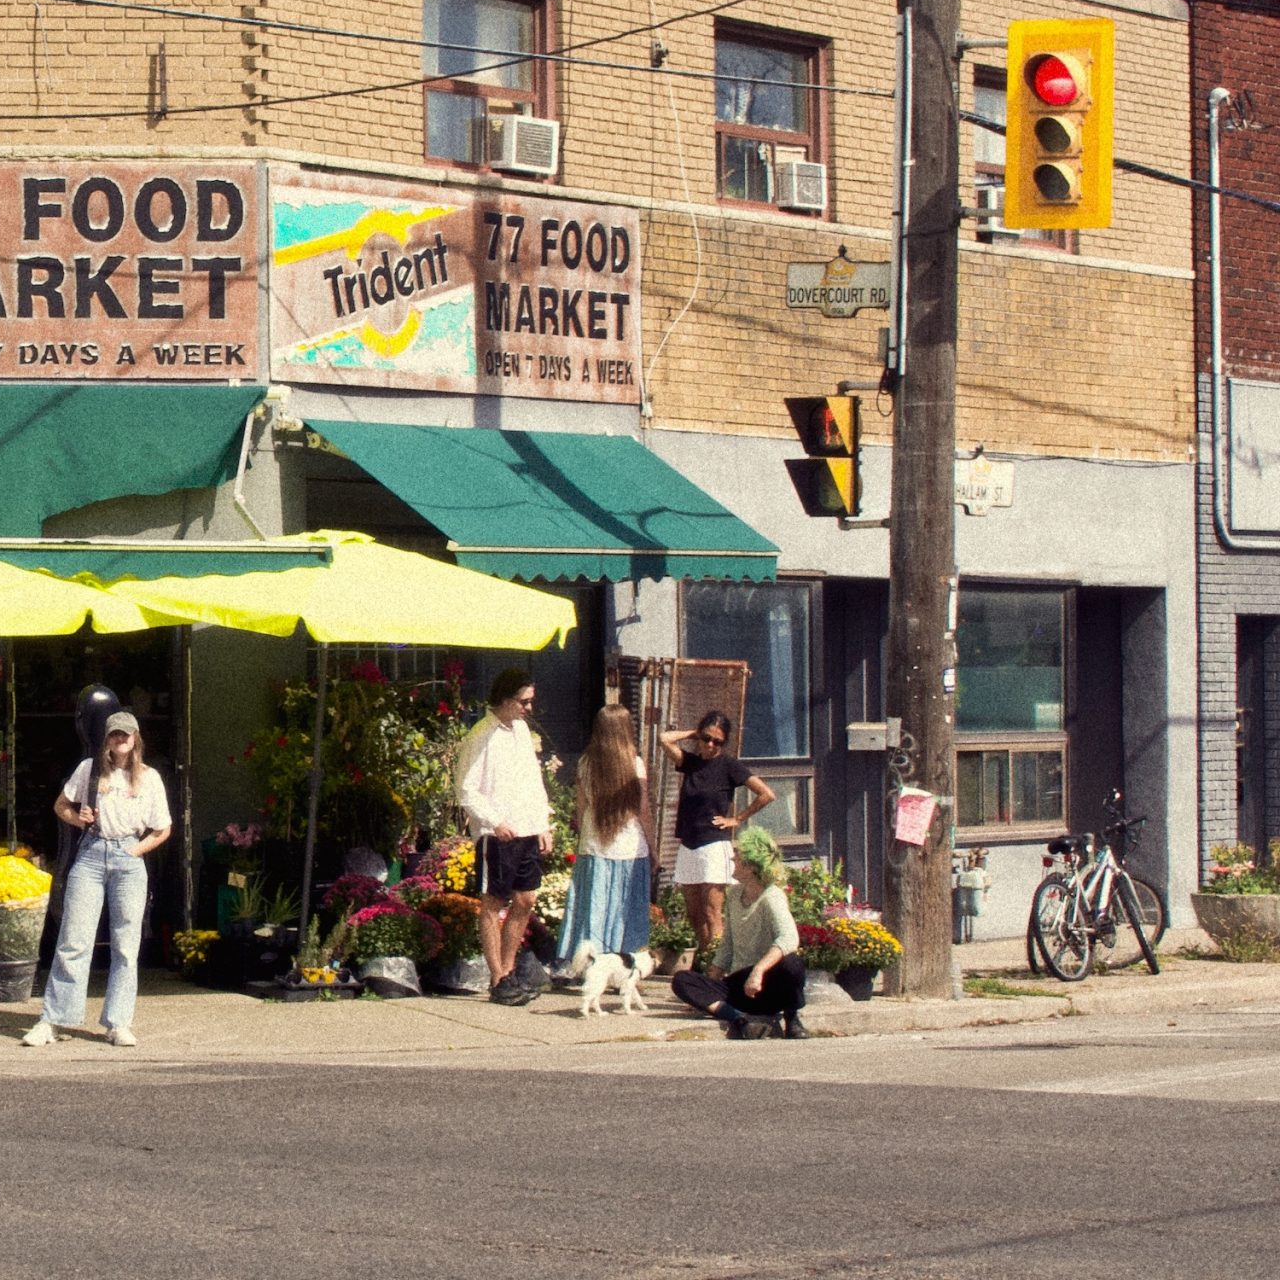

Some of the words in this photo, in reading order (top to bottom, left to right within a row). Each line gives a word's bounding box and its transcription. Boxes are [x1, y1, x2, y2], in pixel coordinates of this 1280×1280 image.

[22, 176, 245, 243] FOOD
[484, 212, 525, 263] 77
[539, 219, 631, 275] FOOD
[322, 231, 450, 319] Trident
[789, 287, 865, 303] DOVERCOURT
[484, 280, 631, 342] MARKET
[18, 341, 99, 366] DAYS
[115, 341, 137, 366] A
[152, 341, 247, 367] WEEK
[484, 350, 520, 377] OPEN
[525, 354, 533, 379] 7
[538, 354, 571, 382] DAYS
[581, 358, 591, 383] A
[597, 360, 635, 386] WEEK
